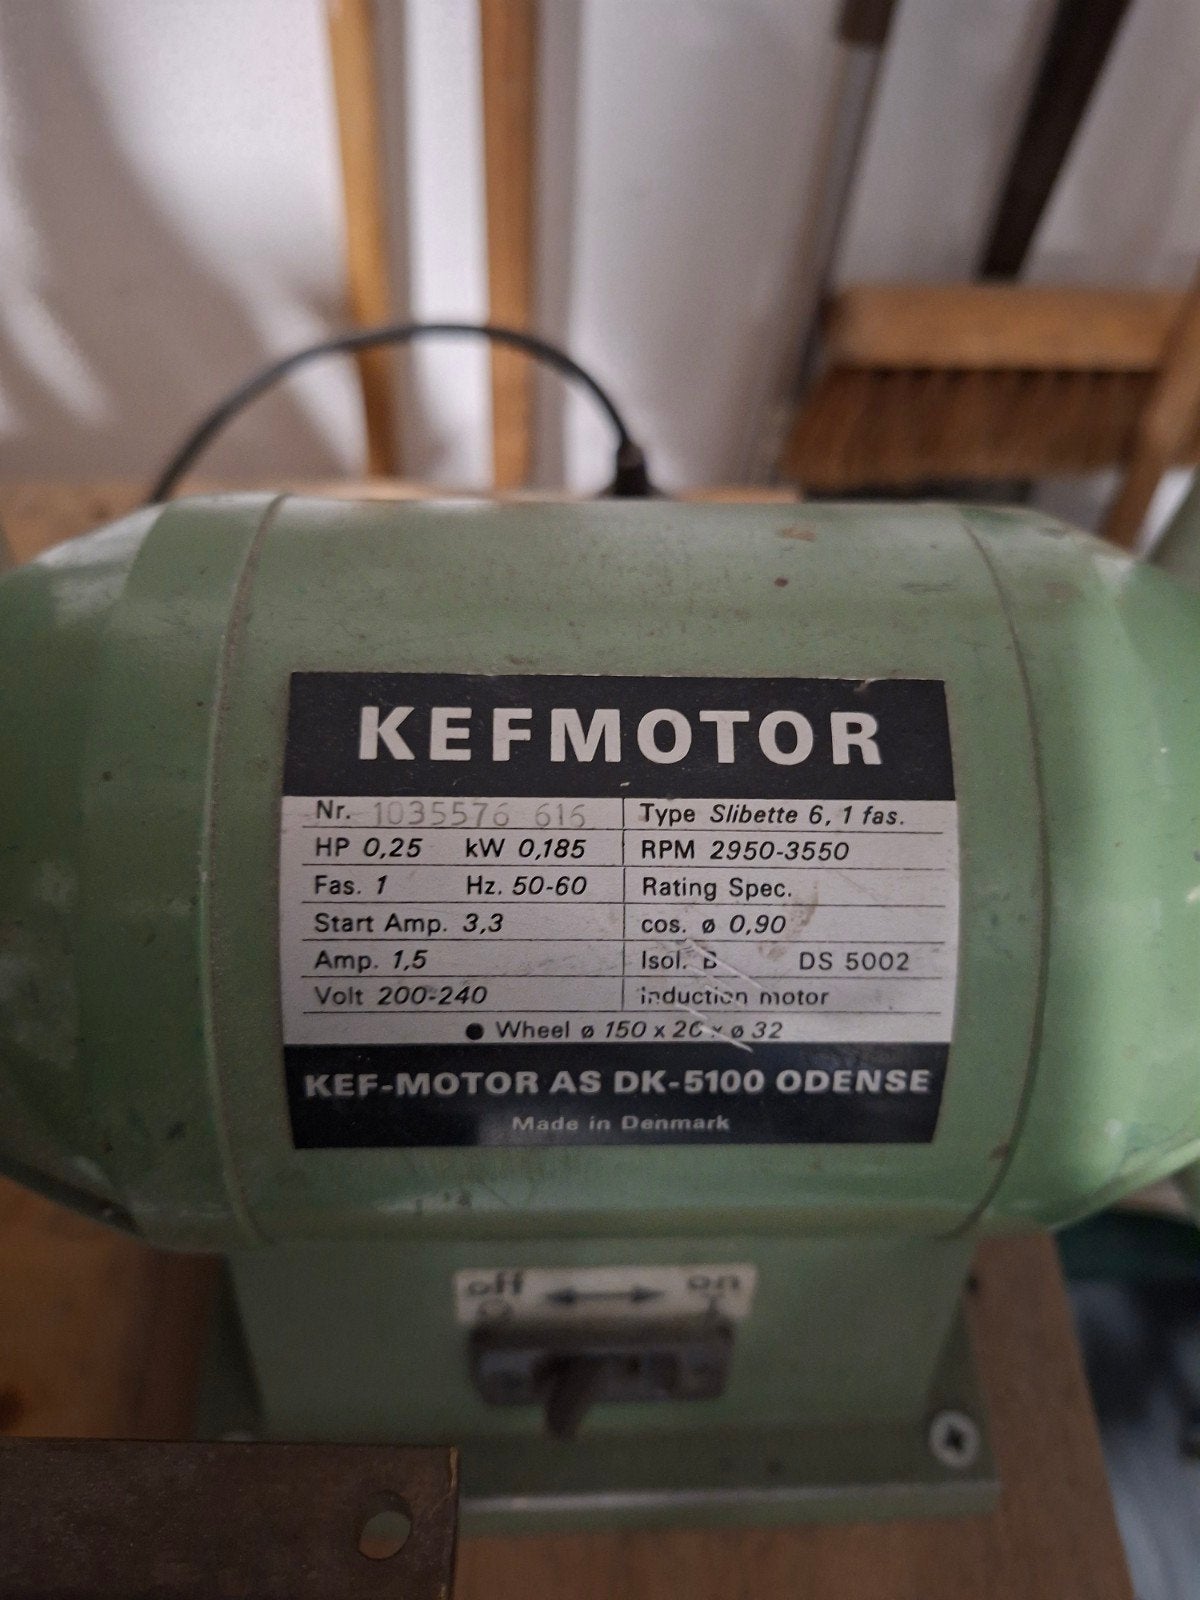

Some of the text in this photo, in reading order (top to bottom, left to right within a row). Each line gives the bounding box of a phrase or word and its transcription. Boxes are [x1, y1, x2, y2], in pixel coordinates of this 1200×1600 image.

[358, 706, 882, 765] KEFMOTOR
[315, 800, 351, 820] Nr.
[373, 800, 510, 827] 1035576
[640, 803, 904, 827] Type Slibette 6, 1 fas.
[316, 837, 587, 860] HP 0,25 kW 0,185
[641, 839, 850, 861] RPM 2950-3550
[315, 874, 588, 896] Fas. 1 Hz. 50-60
[642, 876, 793, 901] Rating Spec.
[314, 913, 504, 937] Start Amp. 3,3
[641, 918, 687, 934] cos.
[729, 914, 787, 936] 0,90
[314, 950, 428, 974] Amp. 1,5
[641, 951, 687, 971] Isol.
[799, 952, 833, 971] DS
[845, 952, 910, 971] 5002
[314, 986, 488, 1006] Volt 200-240
[640, 986, 829, 1006] induction motor
[496, 1021, 569, 1039] Wheel
[604, 1021, 647, 1039] 150
[653, 1025, 666, 1039] x
[751, 1021, 784, 1039] 32
[304, 1068, 931, 1098] KEF-MOTOR AS DK-5100 ODENSE
[511, 1113, 731, 1132] Made in Denmark
[466, 1267, 526, 1296] off
[685, 1274, 741, 1292] on
